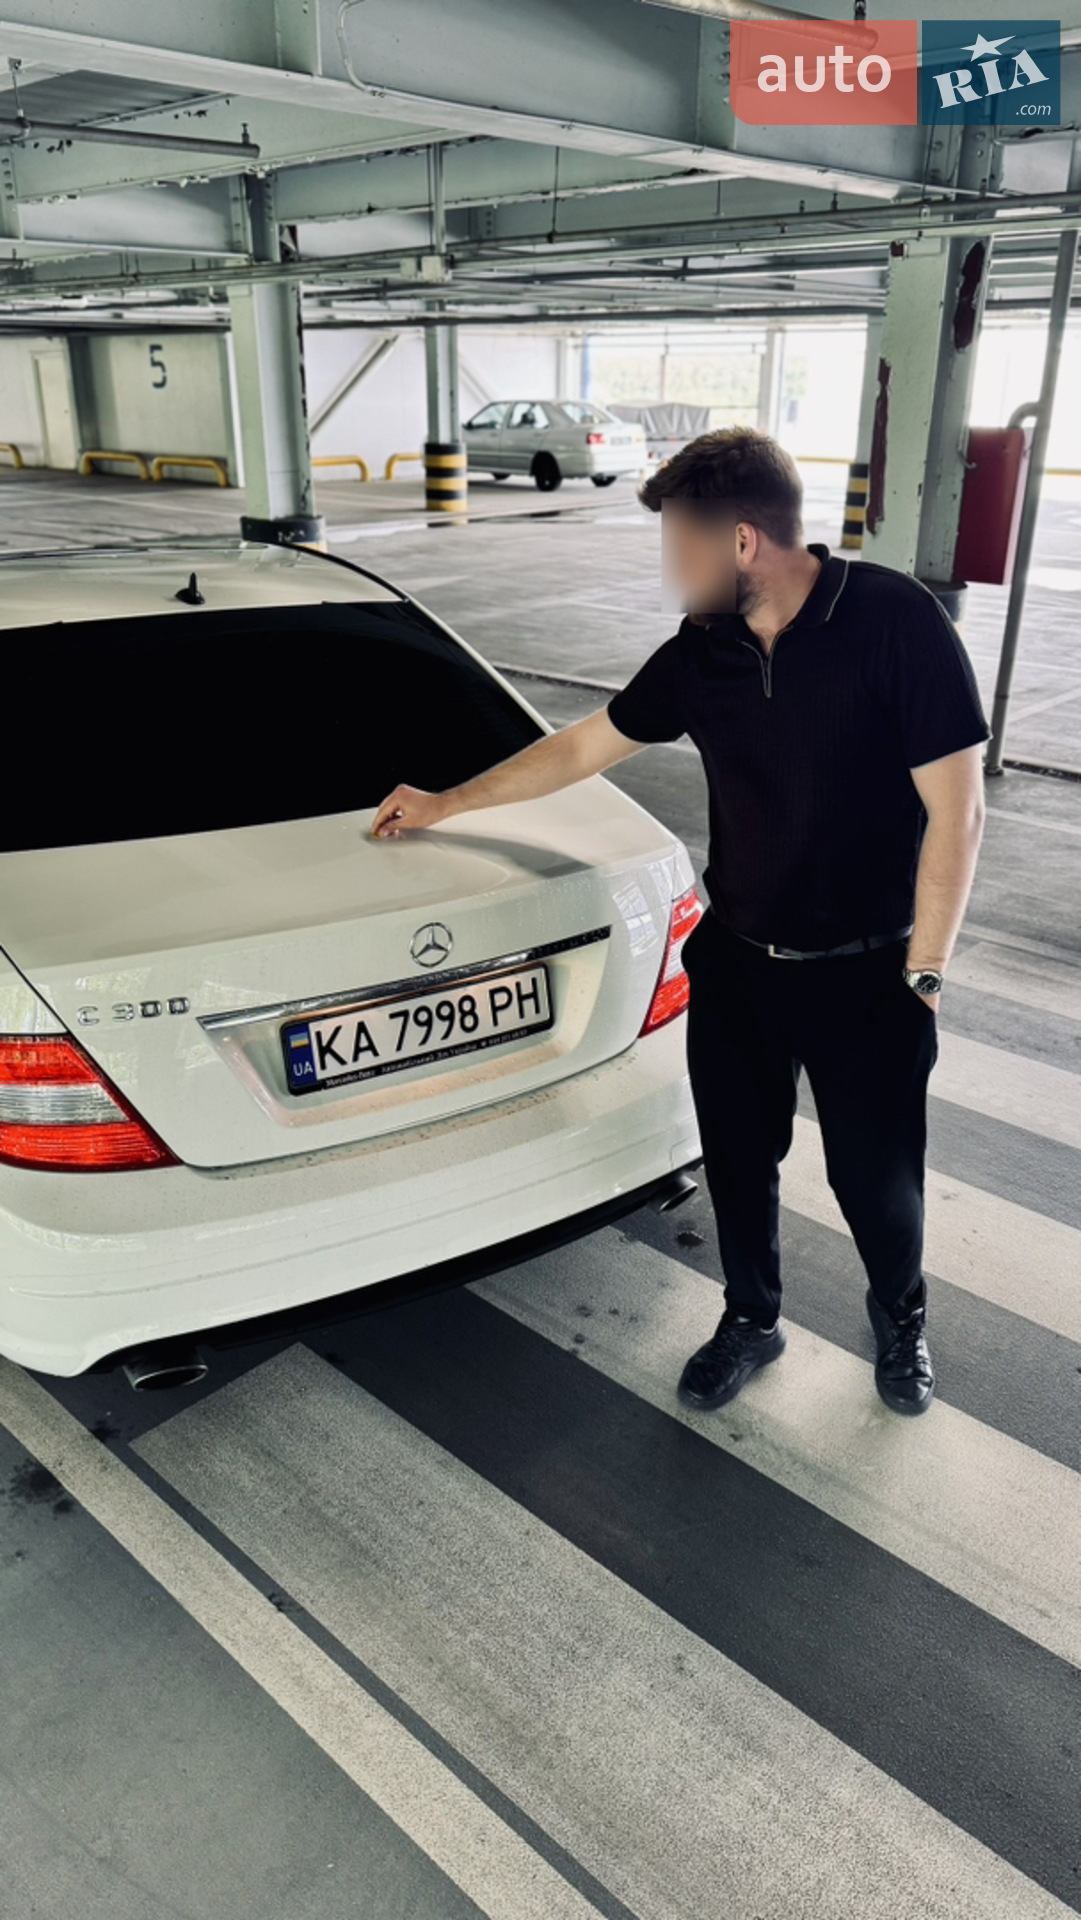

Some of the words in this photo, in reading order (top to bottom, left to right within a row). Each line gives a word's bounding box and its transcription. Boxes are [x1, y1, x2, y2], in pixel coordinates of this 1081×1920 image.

[149, 344, 168, 389] 5
[78, 1006, 100, 1026] C
[111, 997, 190, 1022] 300
[315, 1020, 380, 1071] KA
[389, 994, 479, 1052] 7998
[488, 977, 541, 1027] PH
[292, 1060, 313, 1077] UA
